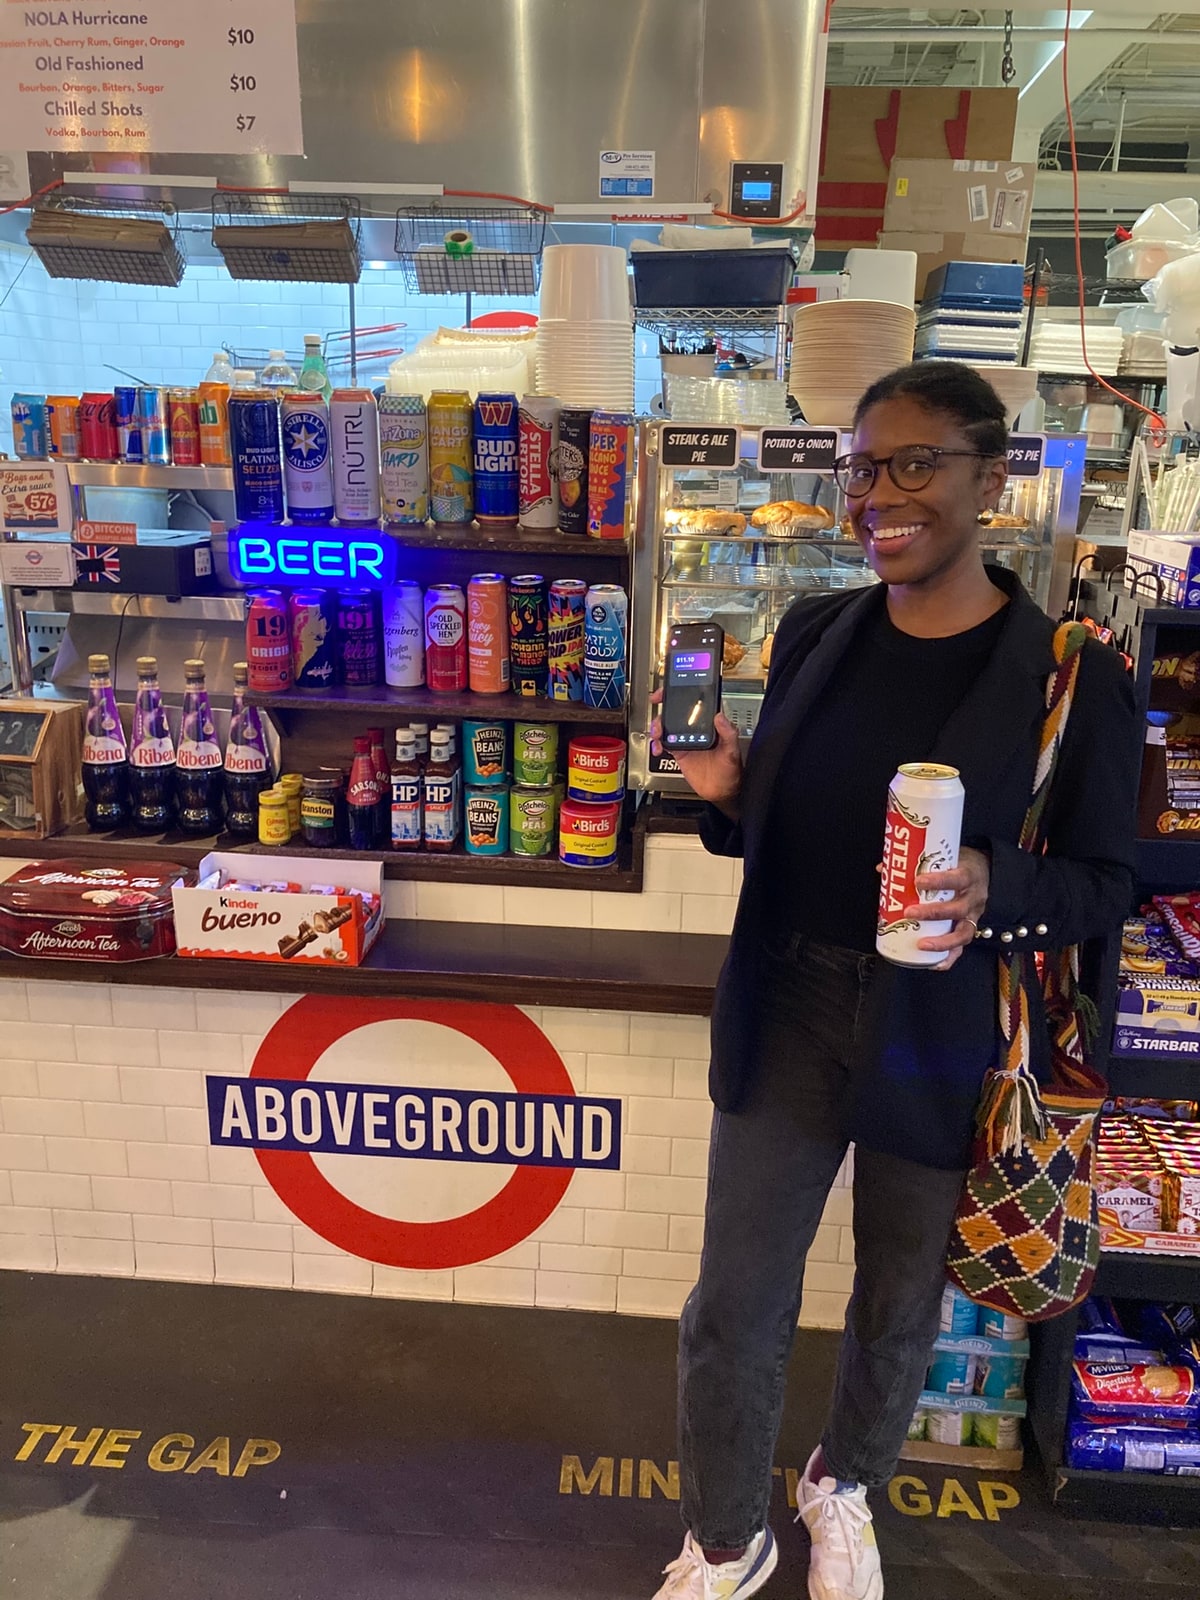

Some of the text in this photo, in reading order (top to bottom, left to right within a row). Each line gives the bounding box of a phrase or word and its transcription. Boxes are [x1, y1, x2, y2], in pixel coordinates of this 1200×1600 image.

[25, 11, 148, 26] NOLA Hurricane
[0, 36, 185, 48] assion Fruit, Cherry Rum, Ginger, Orange
[228, 28, 254, 46] $10
[35, 55, 144, 71] Old Fashioned
[102, 82, 135, 93] Bitters,
[137, 83, 164, 94] Sugar
[230, 74, 257, 93] $10
[44, 101, 143, 116] Chilled Shots
[236, 113, 256, 131] $7
[46, 127, 146, 138] Vodka, Bourbon, Rum
[284, 414, 326, 433] ESTRELLA
[431, 438, 463, 448] CART
[477, 439, 516, 456] BUD
[668, 434, 729, 446] STEAK & ALE
[764, 438, 834, 449] POTATO & ONION
[239, 454, 280, 464] PLATINU
[288, 454, 324, 468] JALISCO
[383, 452, 420, 468] HARD
[474, 454, 519, 472] LIGHT
[519, 430, 529, 495] ARTOIS
[691, 451, 707, 463] PIE
[791, 453, 805, 463] PIE
[1024, 450, 1040, 461] PIE
[529, 431, 542, 496] STELLA
[5, 472, 44, 484] Bags and
[403, 478, 418, 487] Tea
[1, 482, 53, 495] Extra sauce
[30, 494, 55, 509] 57¢
[94, 524, 133, 534] BITCOIN
[238, 537, 384, 579] BEER
[254, 615, 287, 637] 19
[338, 611, 374, 629] 191
[430, 622, 462, 630] SPECKLED
[469, 633, 494, 646] uicy
[548, 626, 582, 644] OWER
[585, 632, 618, 646] PARTLY
[548, 643, 567, 658] RIP
[480, 730, 504, 740] HEINZ
[476, 741, 504, 752] BEANS
[177, 750, 220, 767] Ribena
[226, 753, 263, 769] ibena
[523, 750, 547, 759] PEAS
[579, 754, 609, 768] Bird's
[392, 785, 418, 801] HP
[426, 785, 451, 802] HP
[471, 800, 494, 810] HEINZ
[469, 812, 498, 824] BEANS
[522, 820, 546, 829] PEAS
[580, 820, 610, 832] Bird's
[878, 817, 893, 910] ARTOIS
[888, 825, 910, 912] STELLA
[19, 871, 162, 889] Afternoon Tea
[220, 896, 259, 910] Kinder
[201, 907, 281, 933] bueno
[20, 930, 121, 951] Afternoon Tea
[1131, 1038, 1199, 1053] STARBAR
[220, 1084, 612, 1161] ABOVEGROUND
[1098, 1197, 1154, 1206] CARAMEL
[1155, 1240, 1198, 1248] CARAMEL
[1095, 1375, 1136, 1391] Digestives
[957, 1399, 985, 1407] HEINZ
[14, 1422, 281, 1478] THE GAP
[558, 1455, 1021, 1521] MIN GAP
